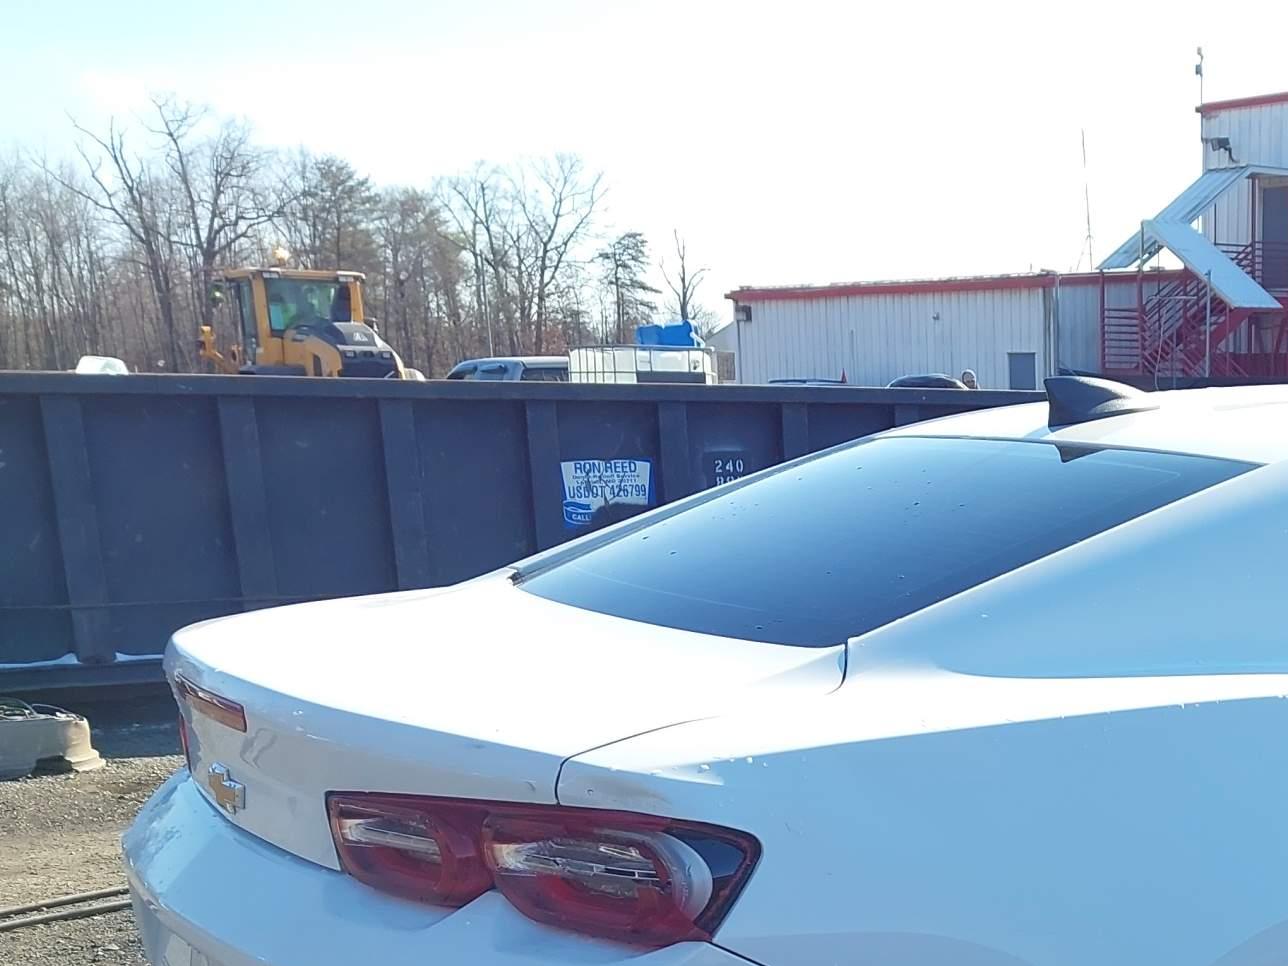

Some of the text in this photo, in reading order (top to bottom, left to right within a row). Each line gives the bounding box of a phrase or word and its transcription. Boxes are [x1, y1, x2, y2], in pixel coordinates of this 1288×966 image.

[574, 461, 637, 474] RON REED
[714, 459, 744, 473] 240
[567, 485, 605, 499] USDOT
[609, 483, 647, 498] 426799
